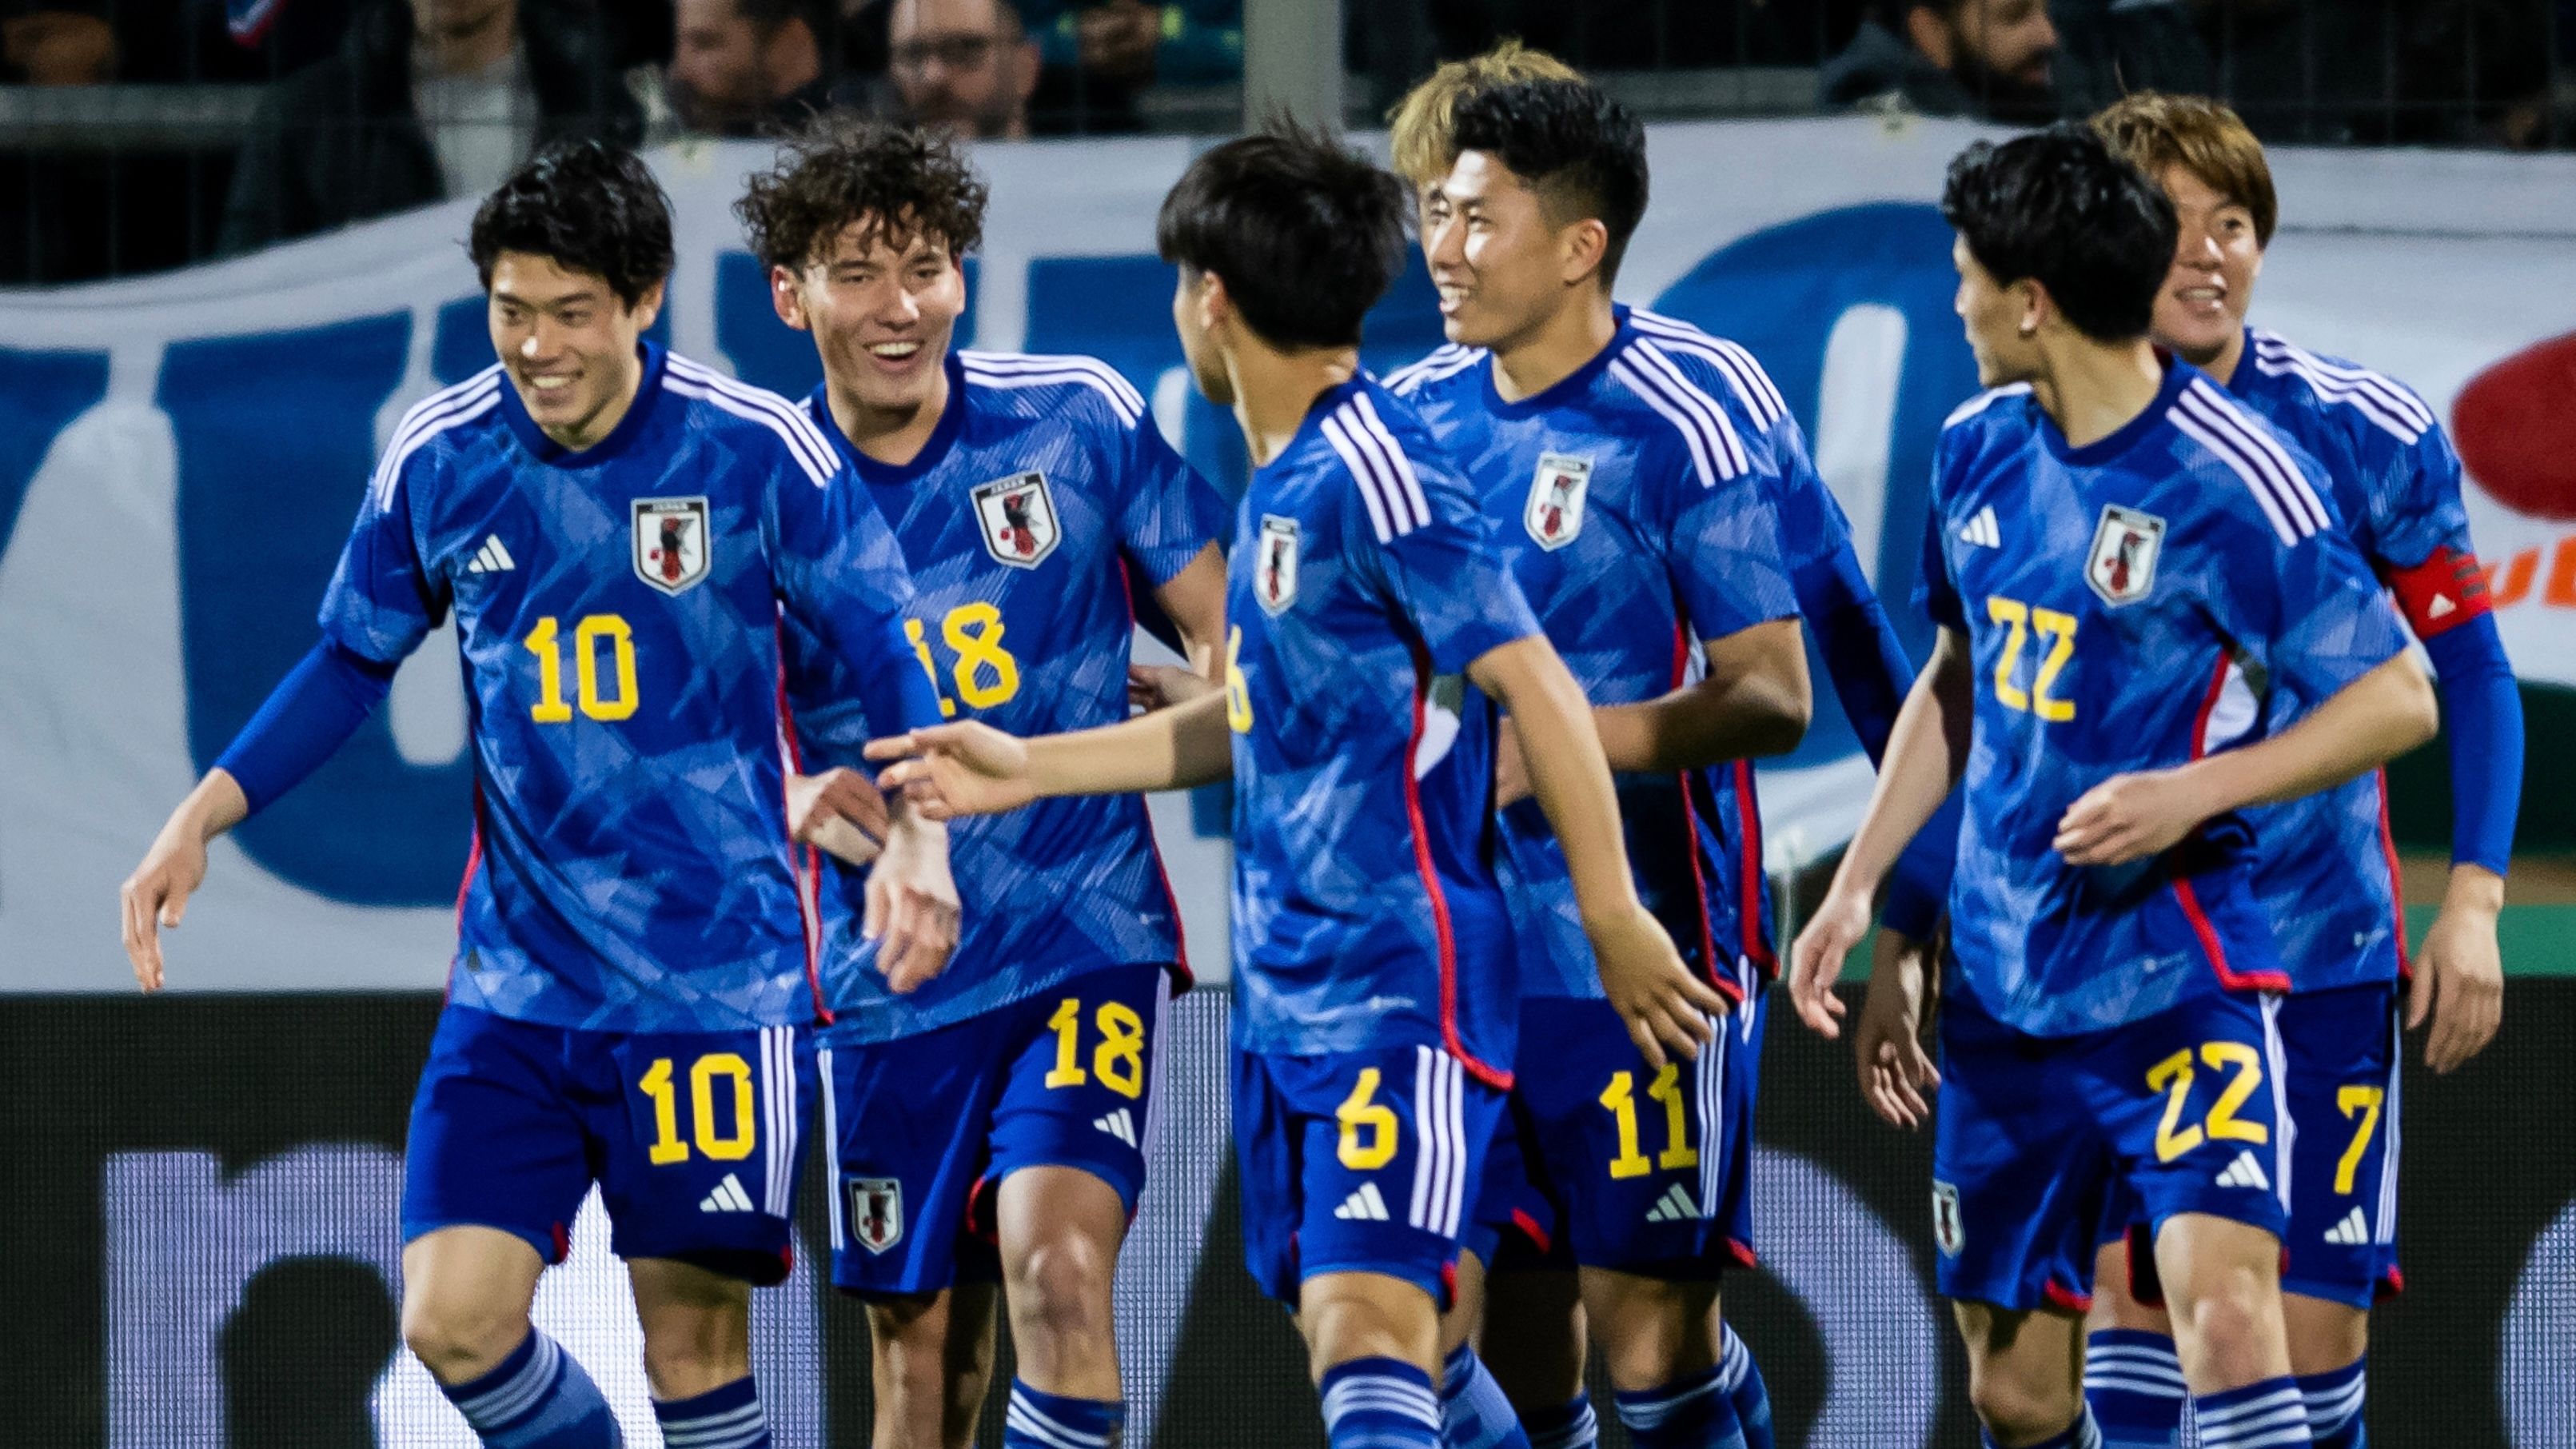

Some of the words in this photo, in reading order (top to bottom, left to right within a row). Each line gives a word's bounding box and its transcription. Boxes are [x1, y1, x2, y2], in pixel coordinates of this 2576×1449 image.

[524, 614, 638, 722] 10
[1987, 596, 2078, 722] 22
[1046, 997, 1145, 1100] 18
[2146, 1041, 2267, 1163] 22
[639, 1053, 755, 1166] 10
[1336, 1068, 1398, 1170] 6
[1599, 1063, 1698, 1180] 11
[2333, 1085, 2384, 1195] 7
